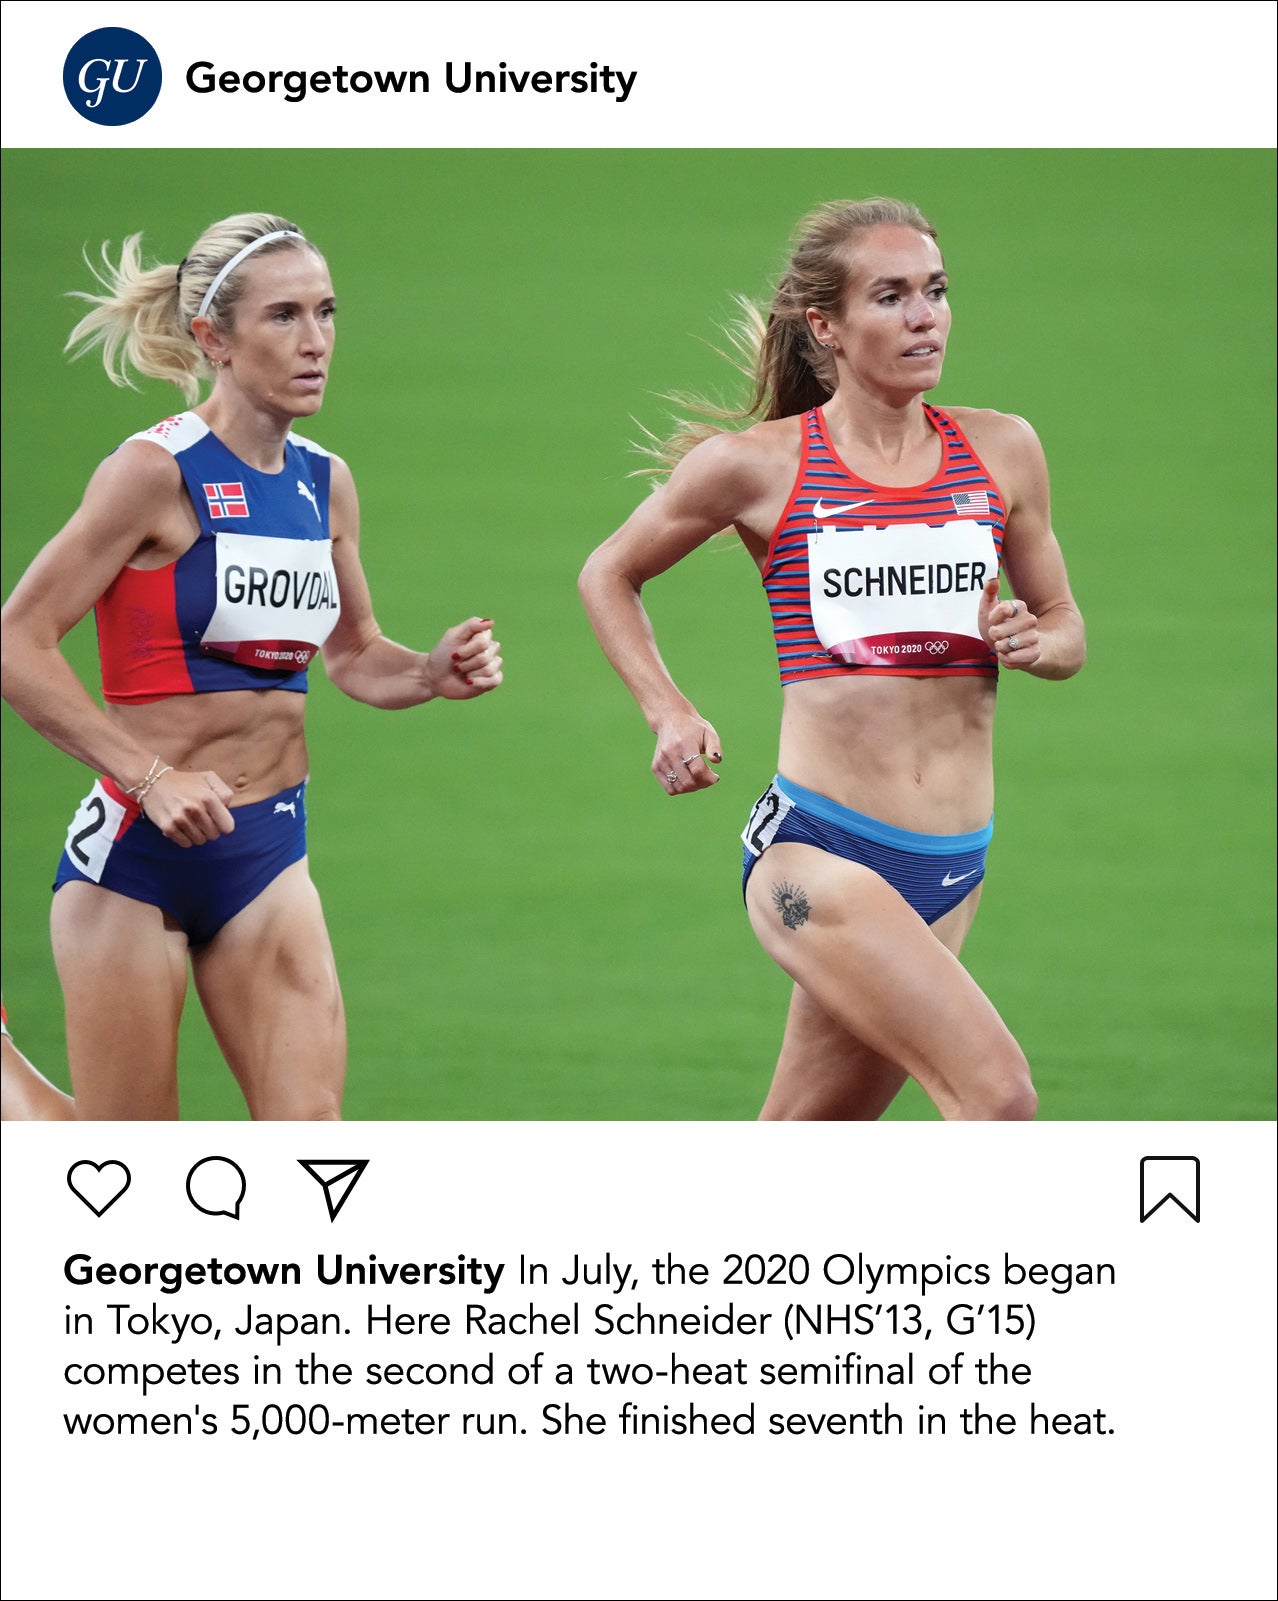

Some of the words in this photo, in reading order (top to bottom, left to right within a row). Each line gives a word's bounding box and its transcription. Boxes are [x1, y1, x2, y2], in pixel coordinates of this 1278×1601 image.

[224, 563, 338, 610] GROVDAL
[823, 561, 987, 598] SCHNEIDER
[871, 645, 900, 655] TOKYO
[901, 644, 922, 654] 2020
[70, 796, 106, 867] 2
